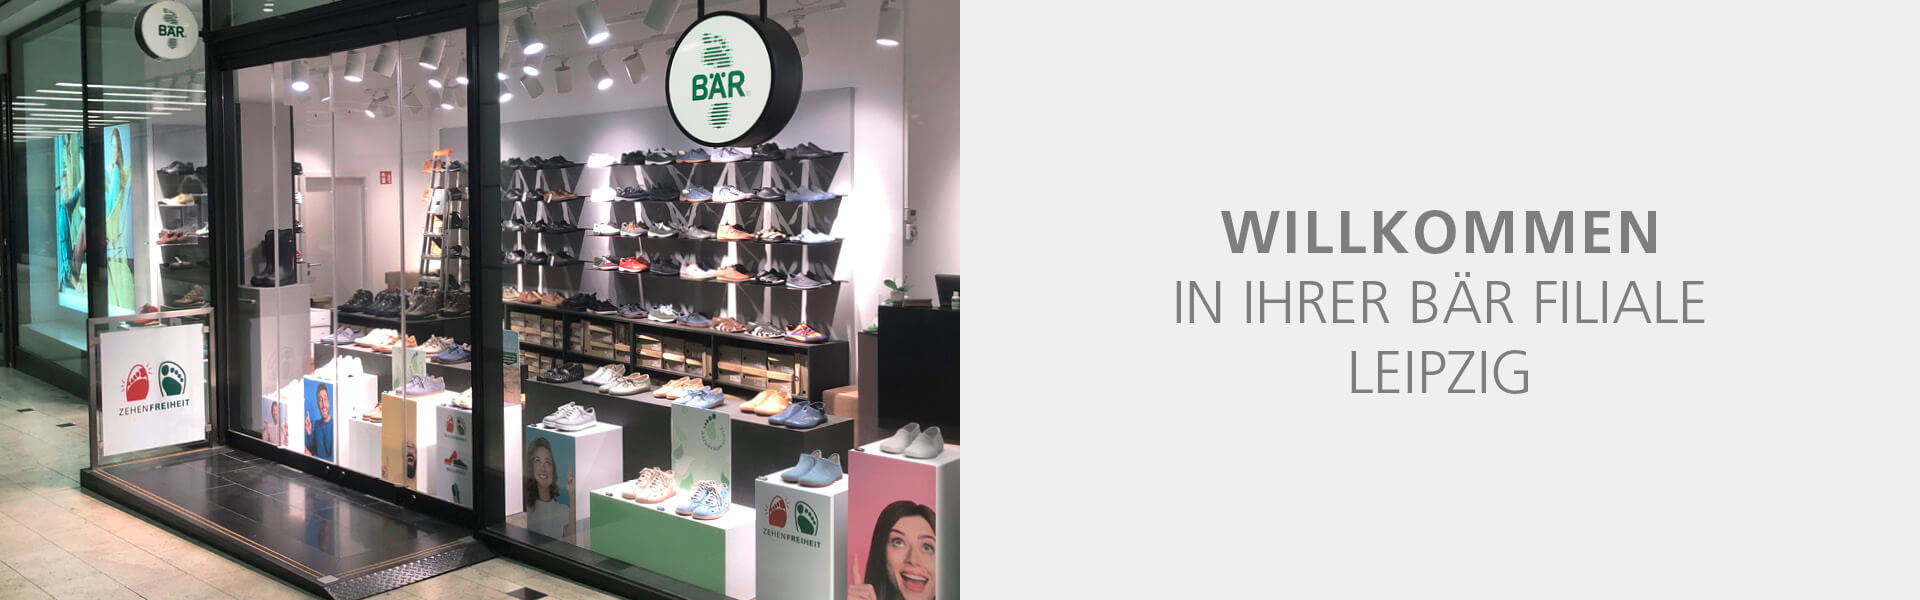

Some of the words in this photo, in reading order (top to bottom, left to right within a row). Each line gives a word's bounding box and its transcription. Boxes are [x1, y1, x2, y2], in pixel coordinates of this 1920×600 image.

[692, 70, 745, 101] BÄR
[119, 399, 190, 416] ZEHENFREIHEIT
[762, 527, 821, 548] ZEHENFREIHEIT
